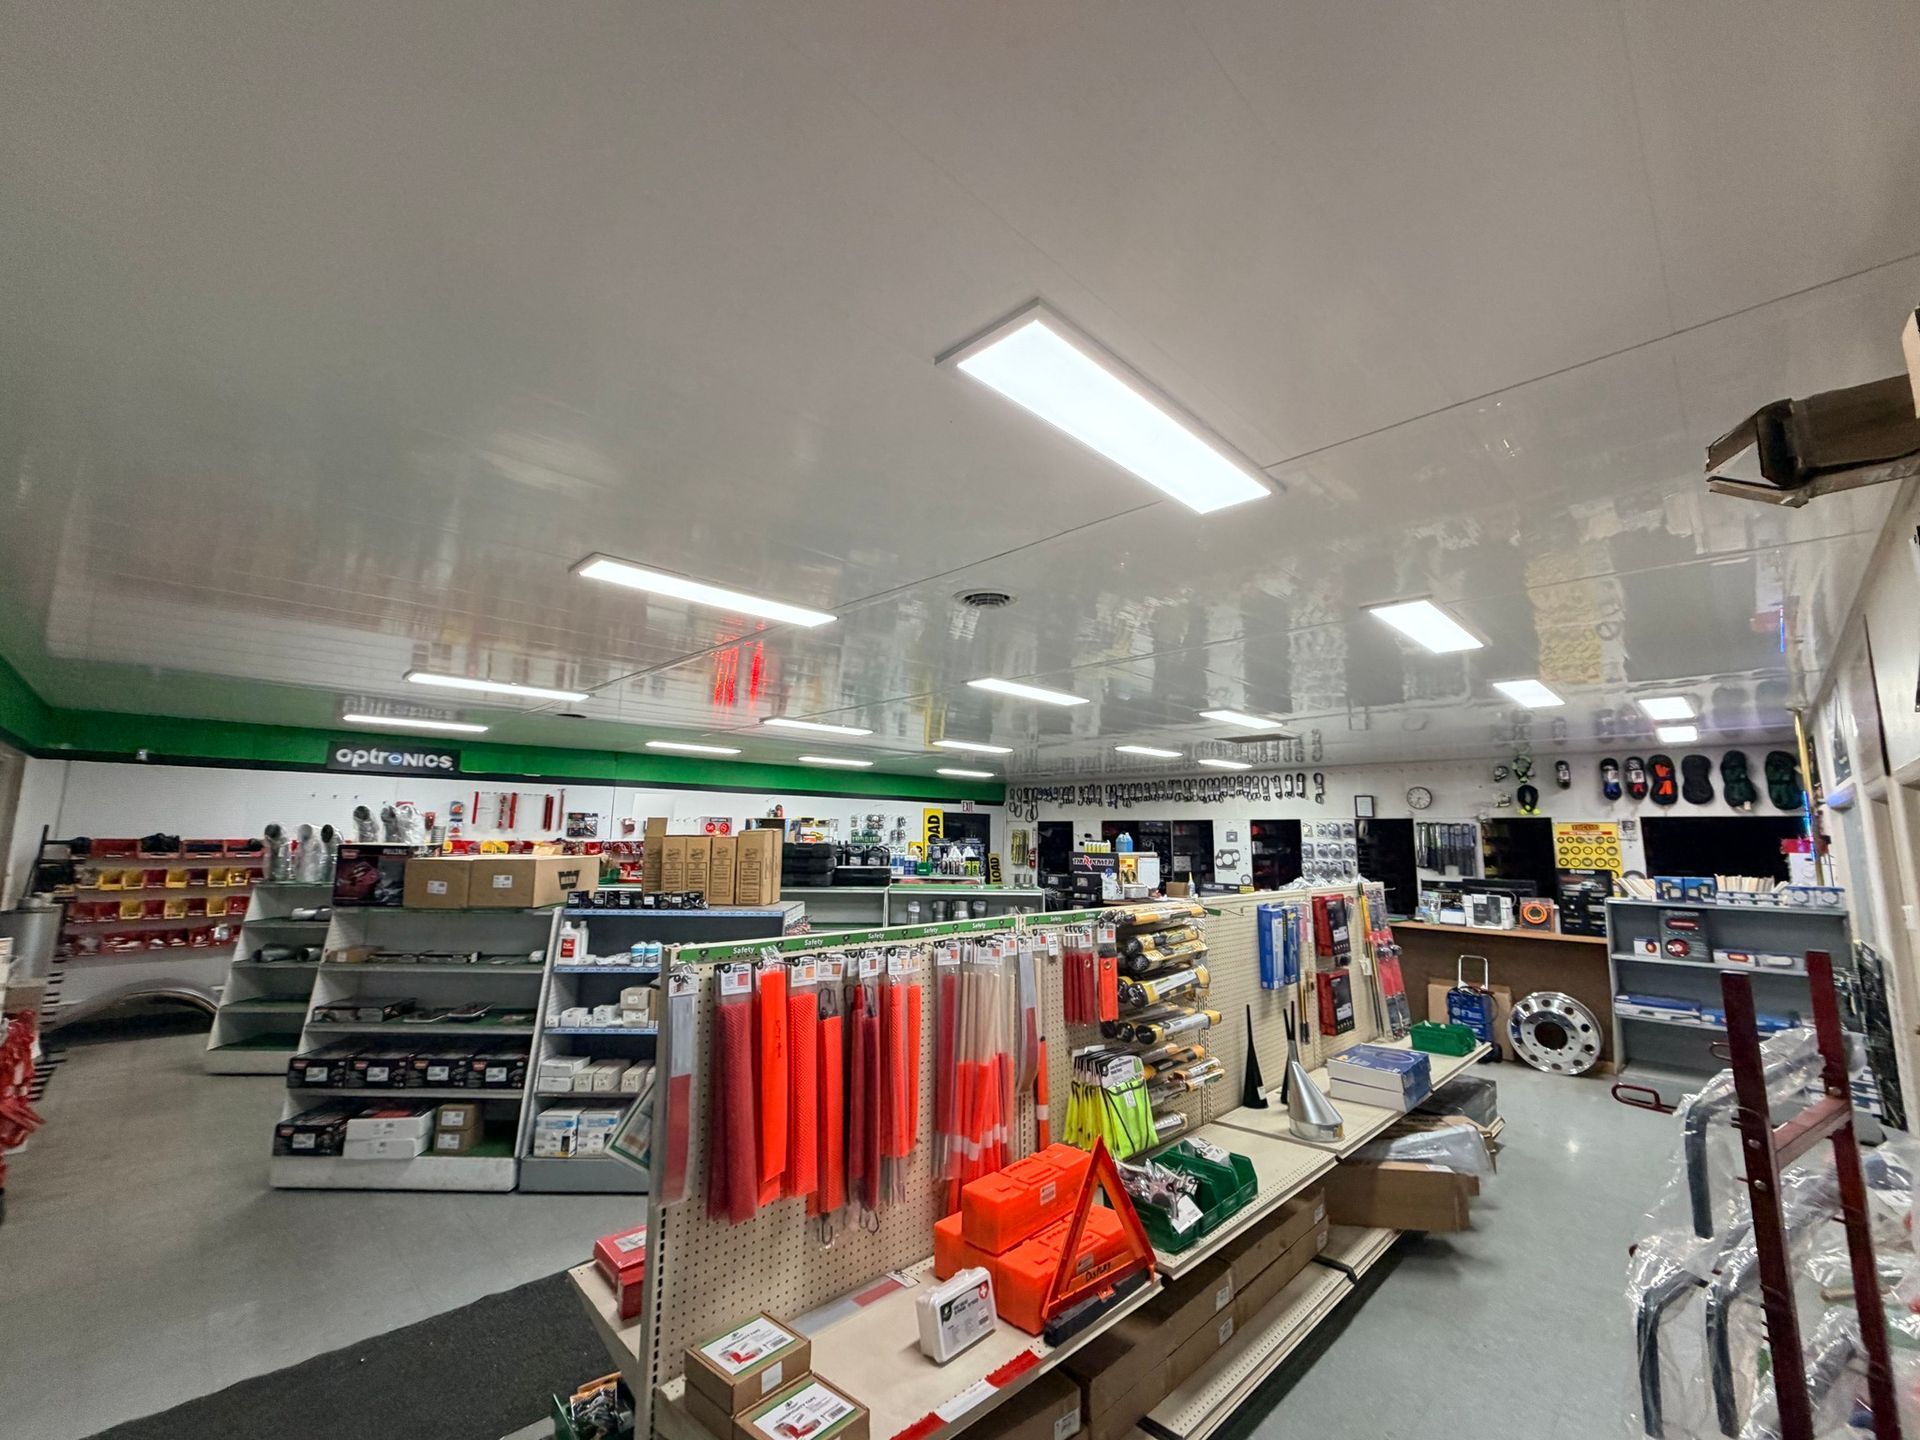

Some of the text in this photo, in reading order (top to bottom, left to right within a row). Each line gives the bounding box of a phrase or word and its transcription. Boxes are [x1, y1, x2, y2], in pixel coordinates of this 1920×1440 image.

[962, 801, 974, 812] EXIT
[927, 814, 941, 845] OAD
[991, 857, 1002, 883] LOAD
[804, 938, 823, 946] Safety
[732, 946, 755, 955] Safety
